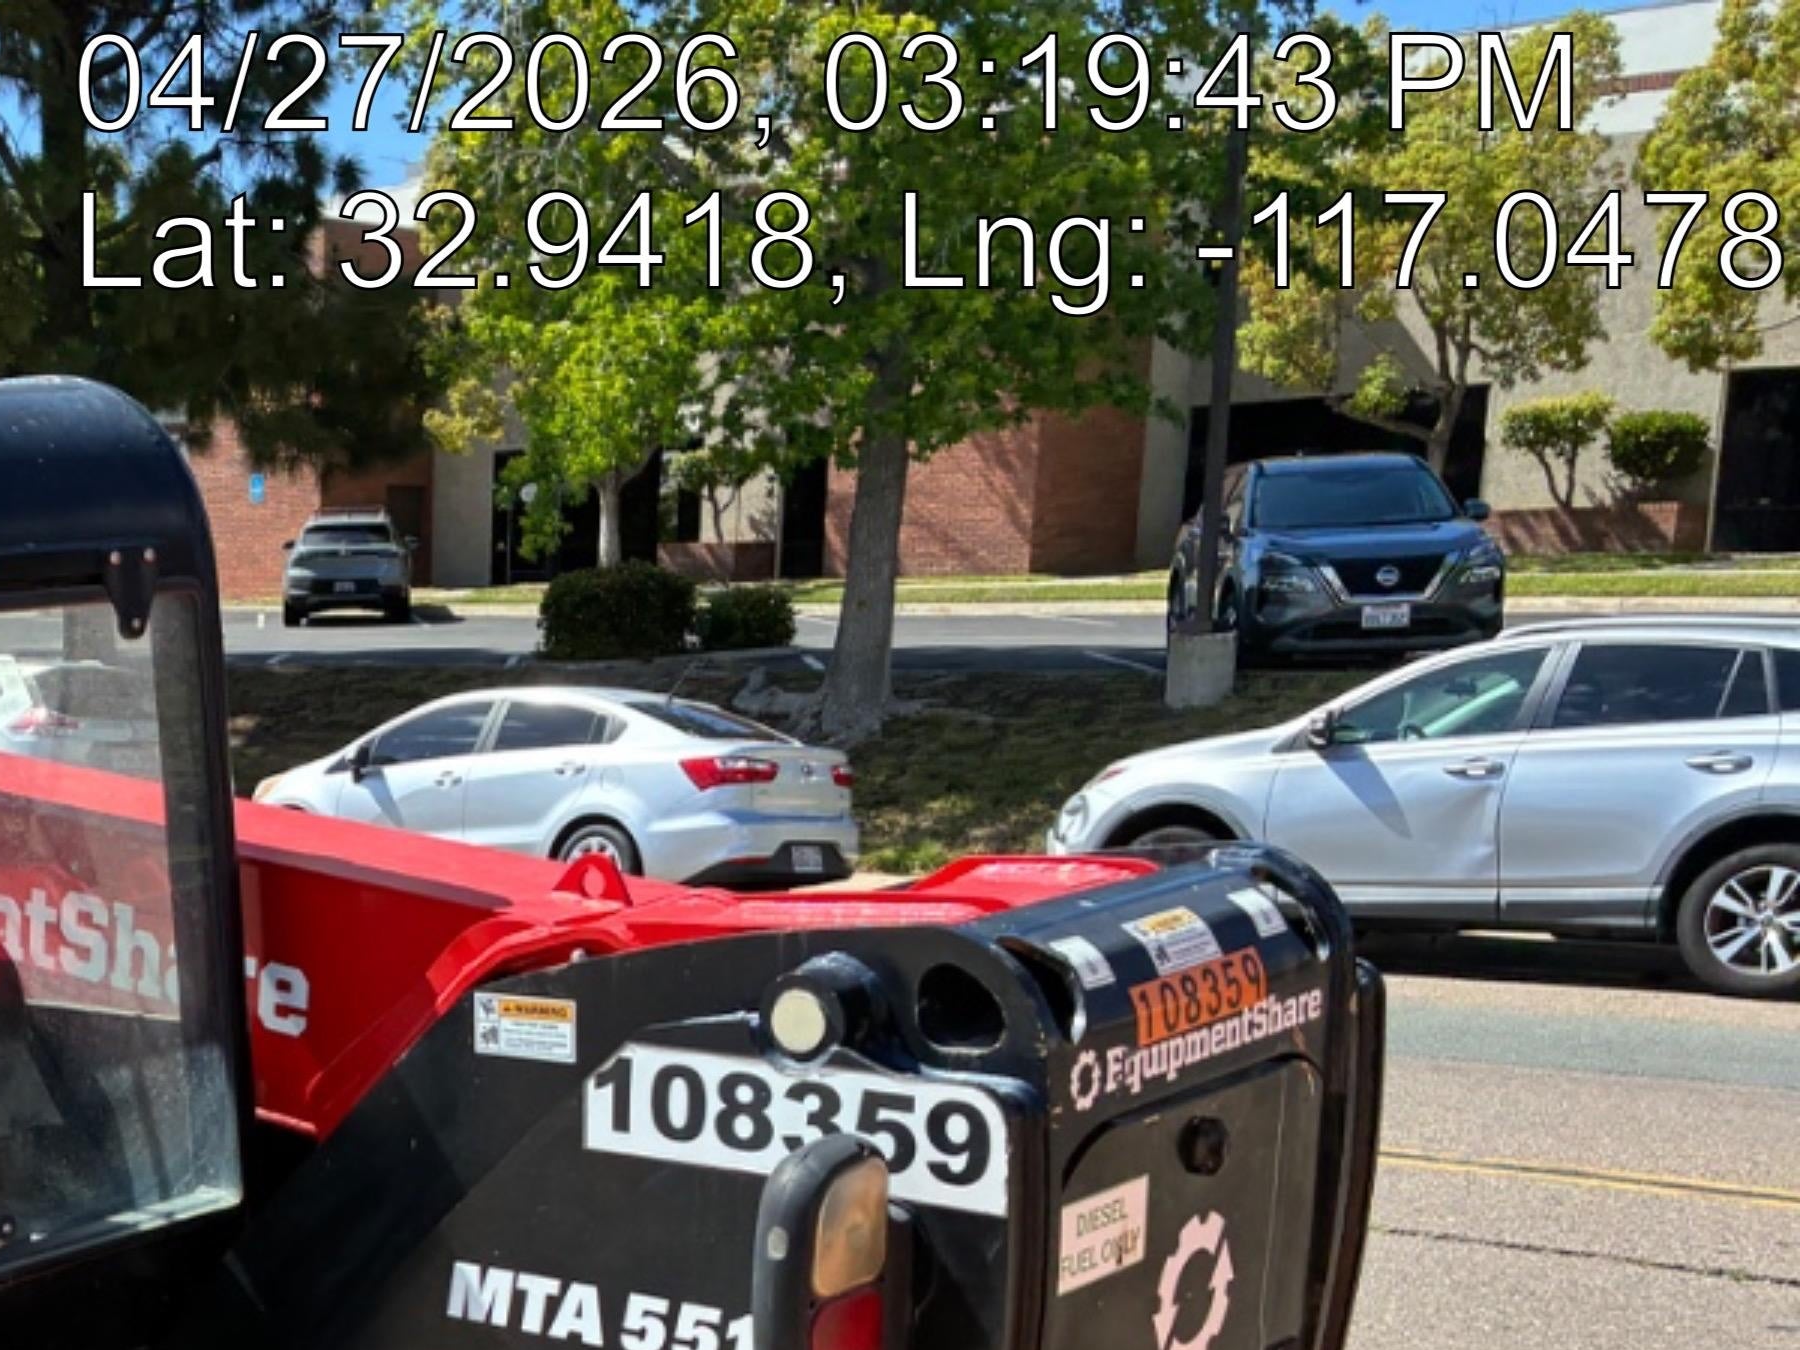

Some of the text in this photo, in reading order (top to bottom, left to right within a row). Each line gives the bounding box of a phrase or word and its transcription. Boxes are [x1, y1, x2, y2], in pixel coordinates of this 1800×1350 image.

[1105, 988, 1322, 1094] EquipmentShare
[1139, 953, 1262, 1043] 108359
[594, 1057, 991, 1186] 108359
[1077, 1198, 1128, 1238] DIESEL
[447, 1260, 604, 1348] MTA
